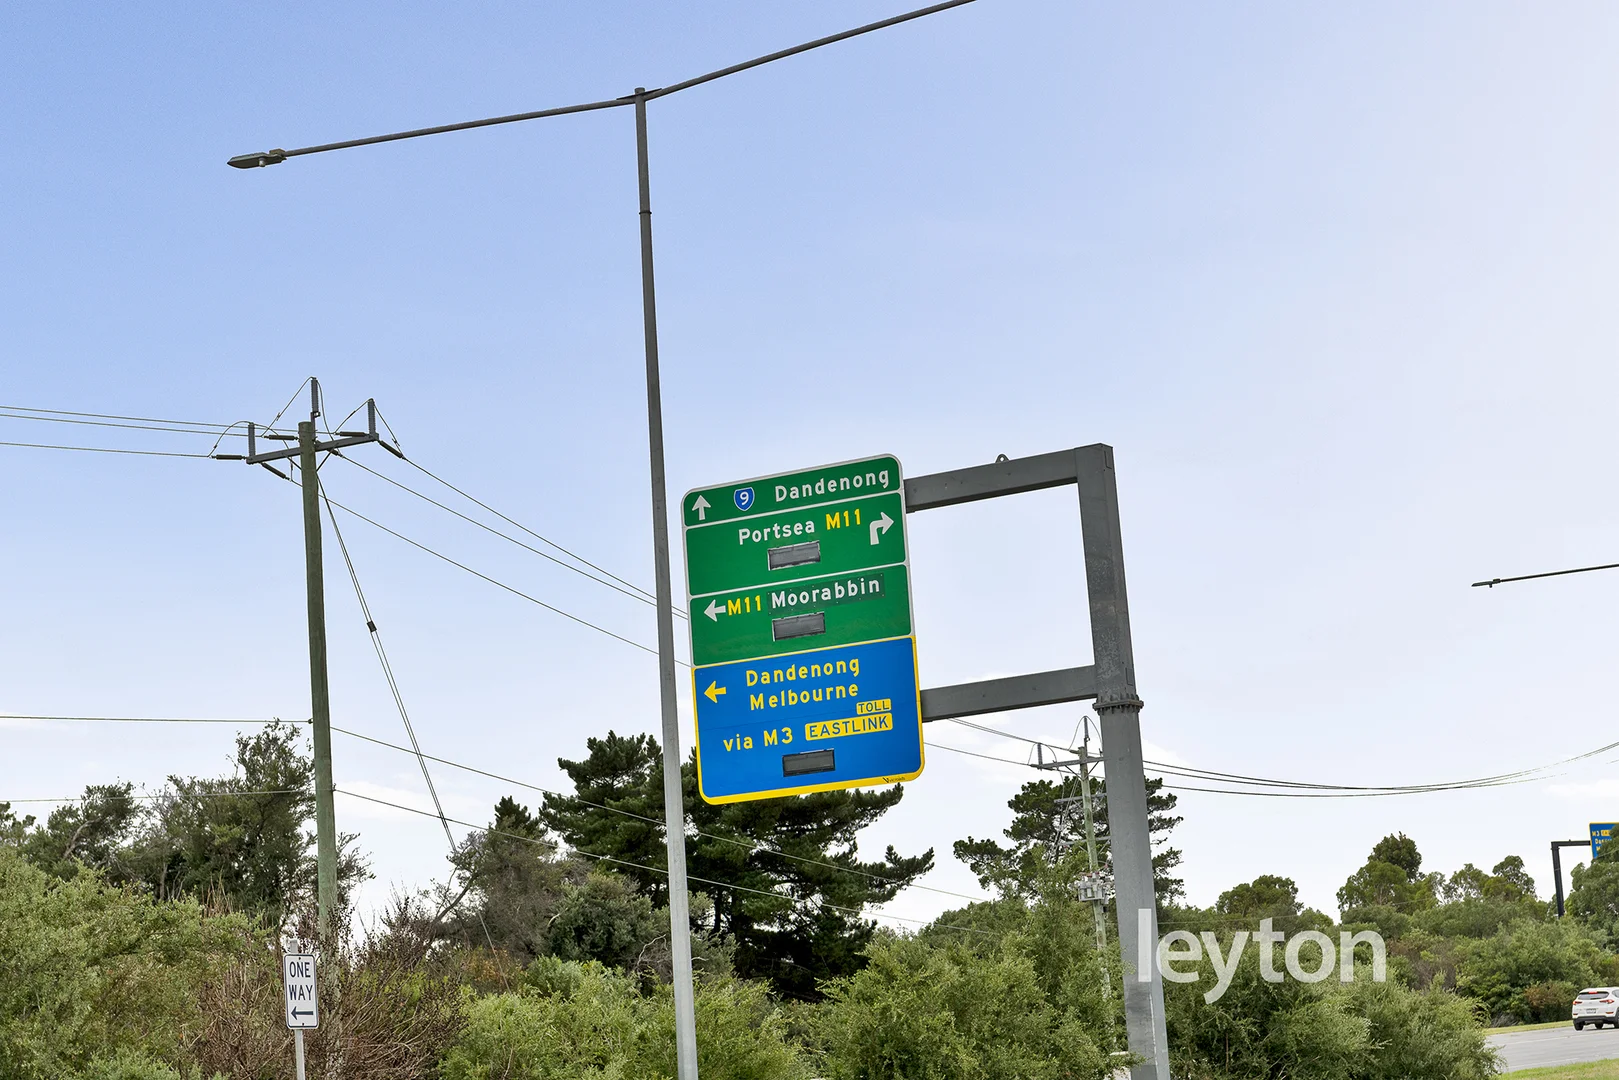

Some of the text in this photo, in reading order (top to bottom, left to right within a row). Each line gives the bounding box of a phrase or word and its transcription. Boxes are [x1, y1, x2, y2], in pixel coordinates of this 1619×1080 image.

[740, 491, 750, 506] 9
[775, 469, 890, 502] Dandenong
[738, 508, 862, 545] Portsea M11
[727, 577, 881, 616] M11 Moorabbin
[746, 658, 860, 687] Dandenong
[750, 683, 859, 711] Melbourne
[858, 700, 890, 714] TOLL
[723, 715, 889, 752] via M3 EASTLINK
[289, 961, 311, 978] ONE
[288, 984, 313, 1001] WAY
